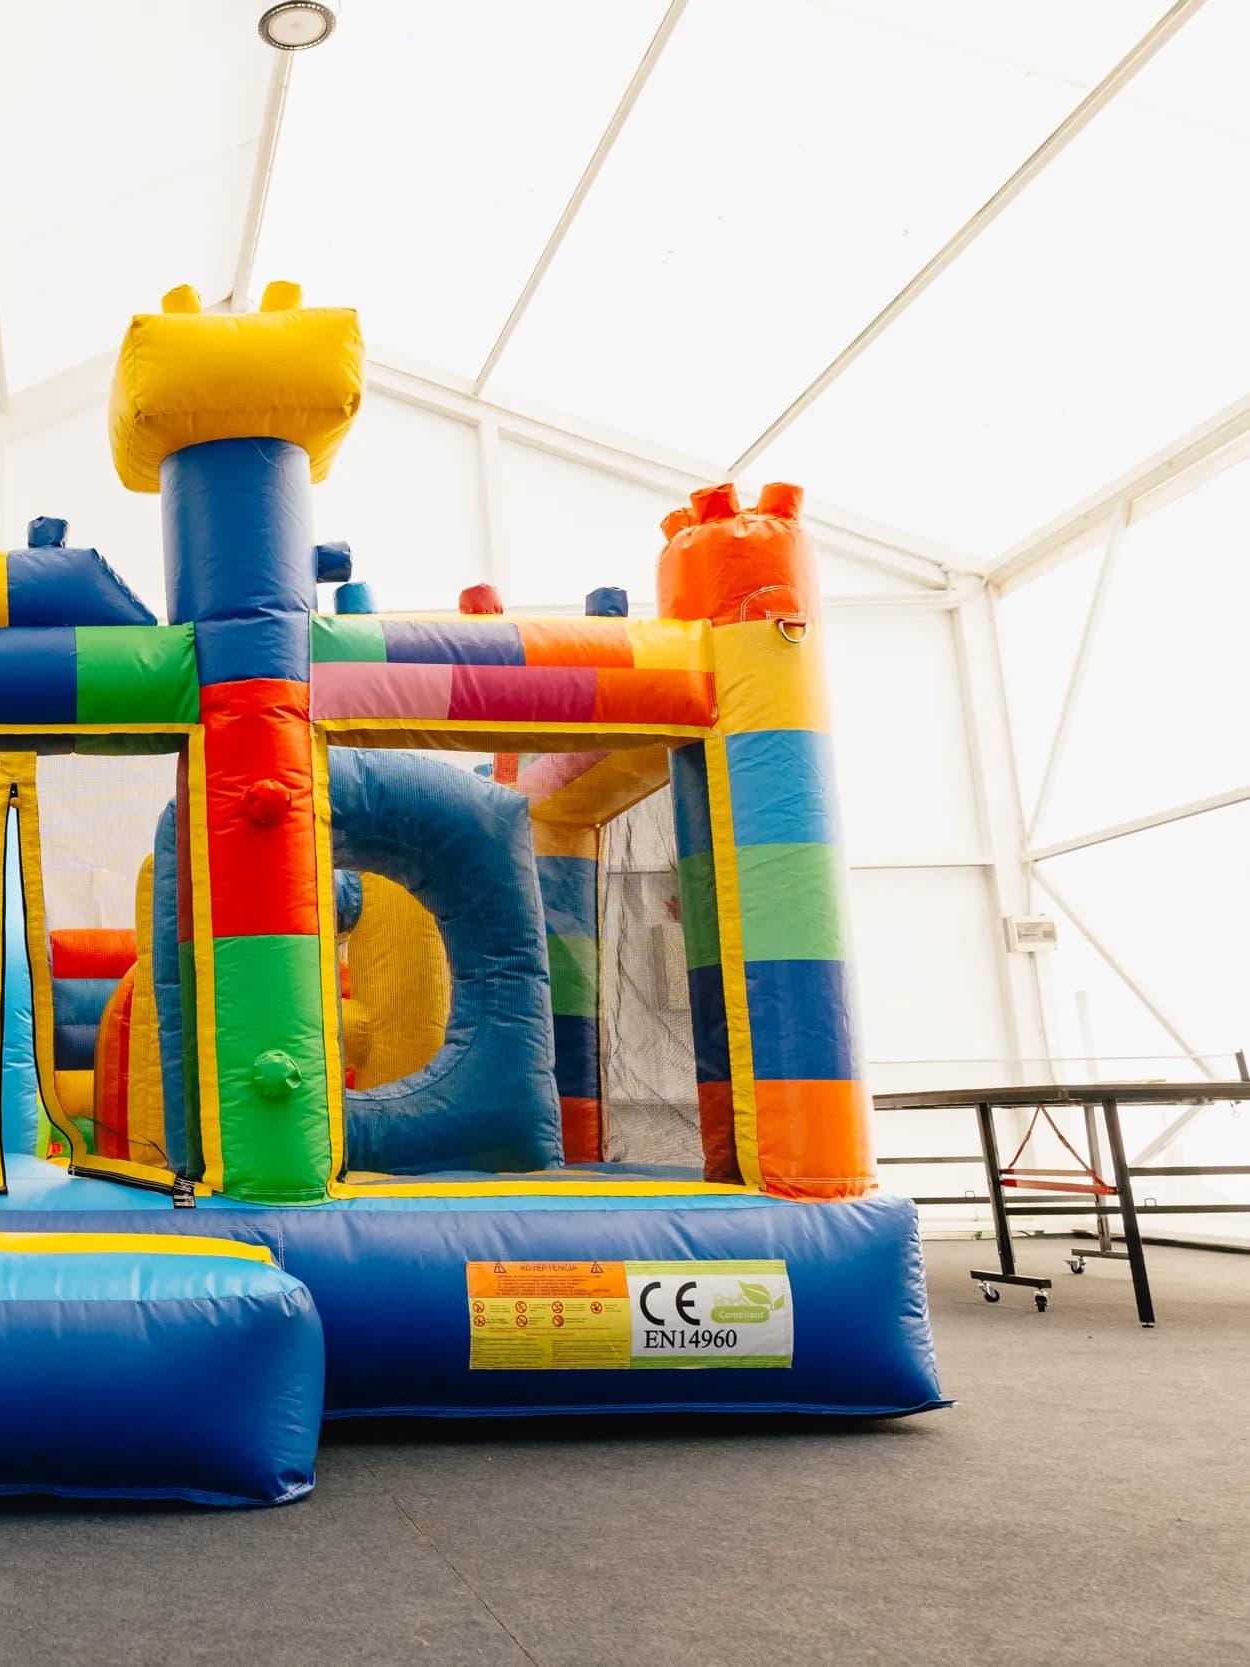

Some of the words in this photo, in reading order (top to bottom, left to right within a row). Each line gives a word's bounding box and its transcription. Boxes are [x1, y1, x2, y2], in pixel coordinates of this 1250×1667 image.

[520, 1262, 578, 1272] ADVERTENCIA
[639, 1281, 701, 1326] CE
[718, 1309, 765, 1321] Compliant
[644, 1329, 738, 1349] EN14960
